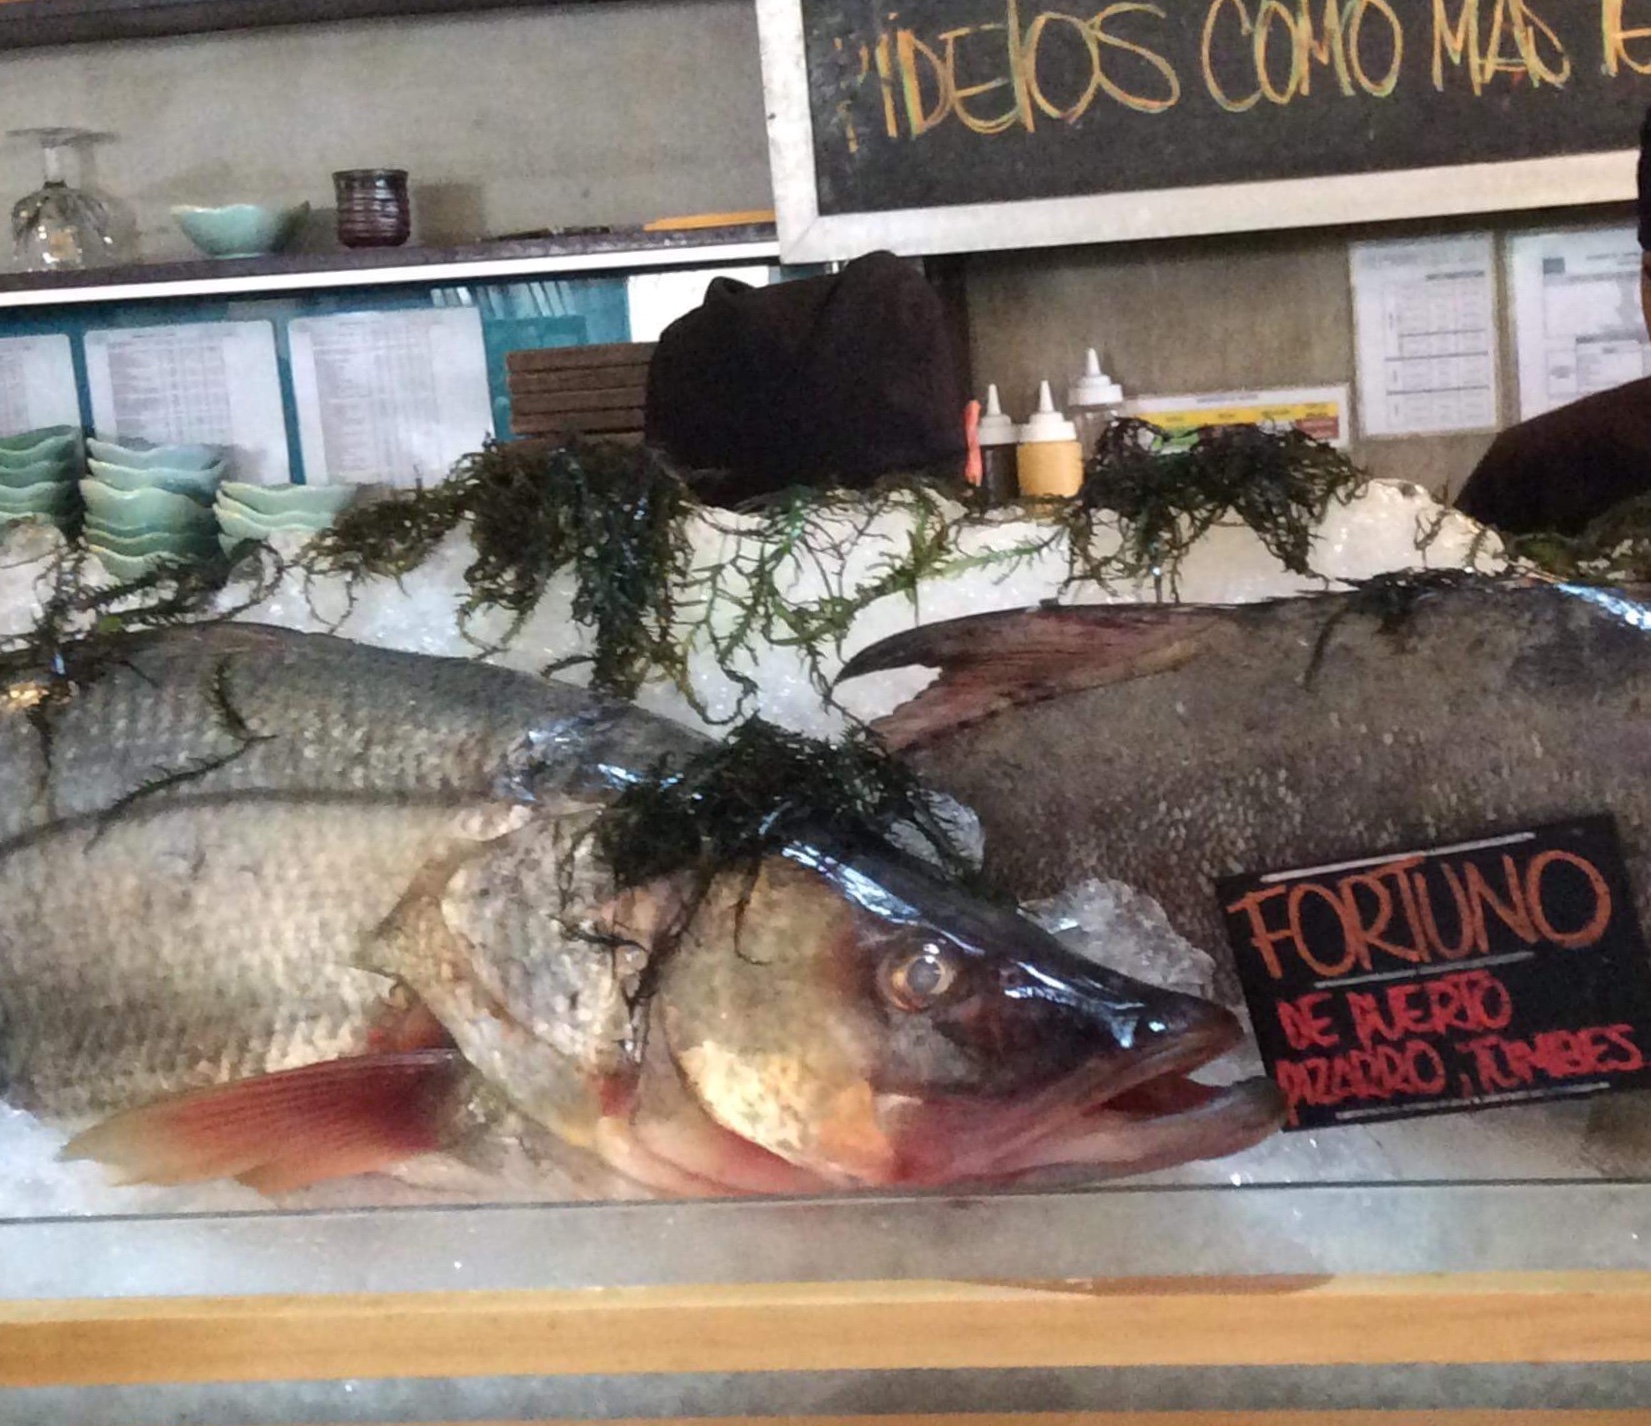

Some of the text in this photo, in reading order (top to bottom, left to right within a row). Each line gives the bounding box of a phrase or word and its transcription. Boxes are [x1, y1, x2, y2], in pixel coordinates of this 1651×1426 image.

[1202, 0, 1404, 113] COMO
[1227, 850, 1612, 979] FORTUNO
[1276, 970, 1512, 1053] DE PUERTO
